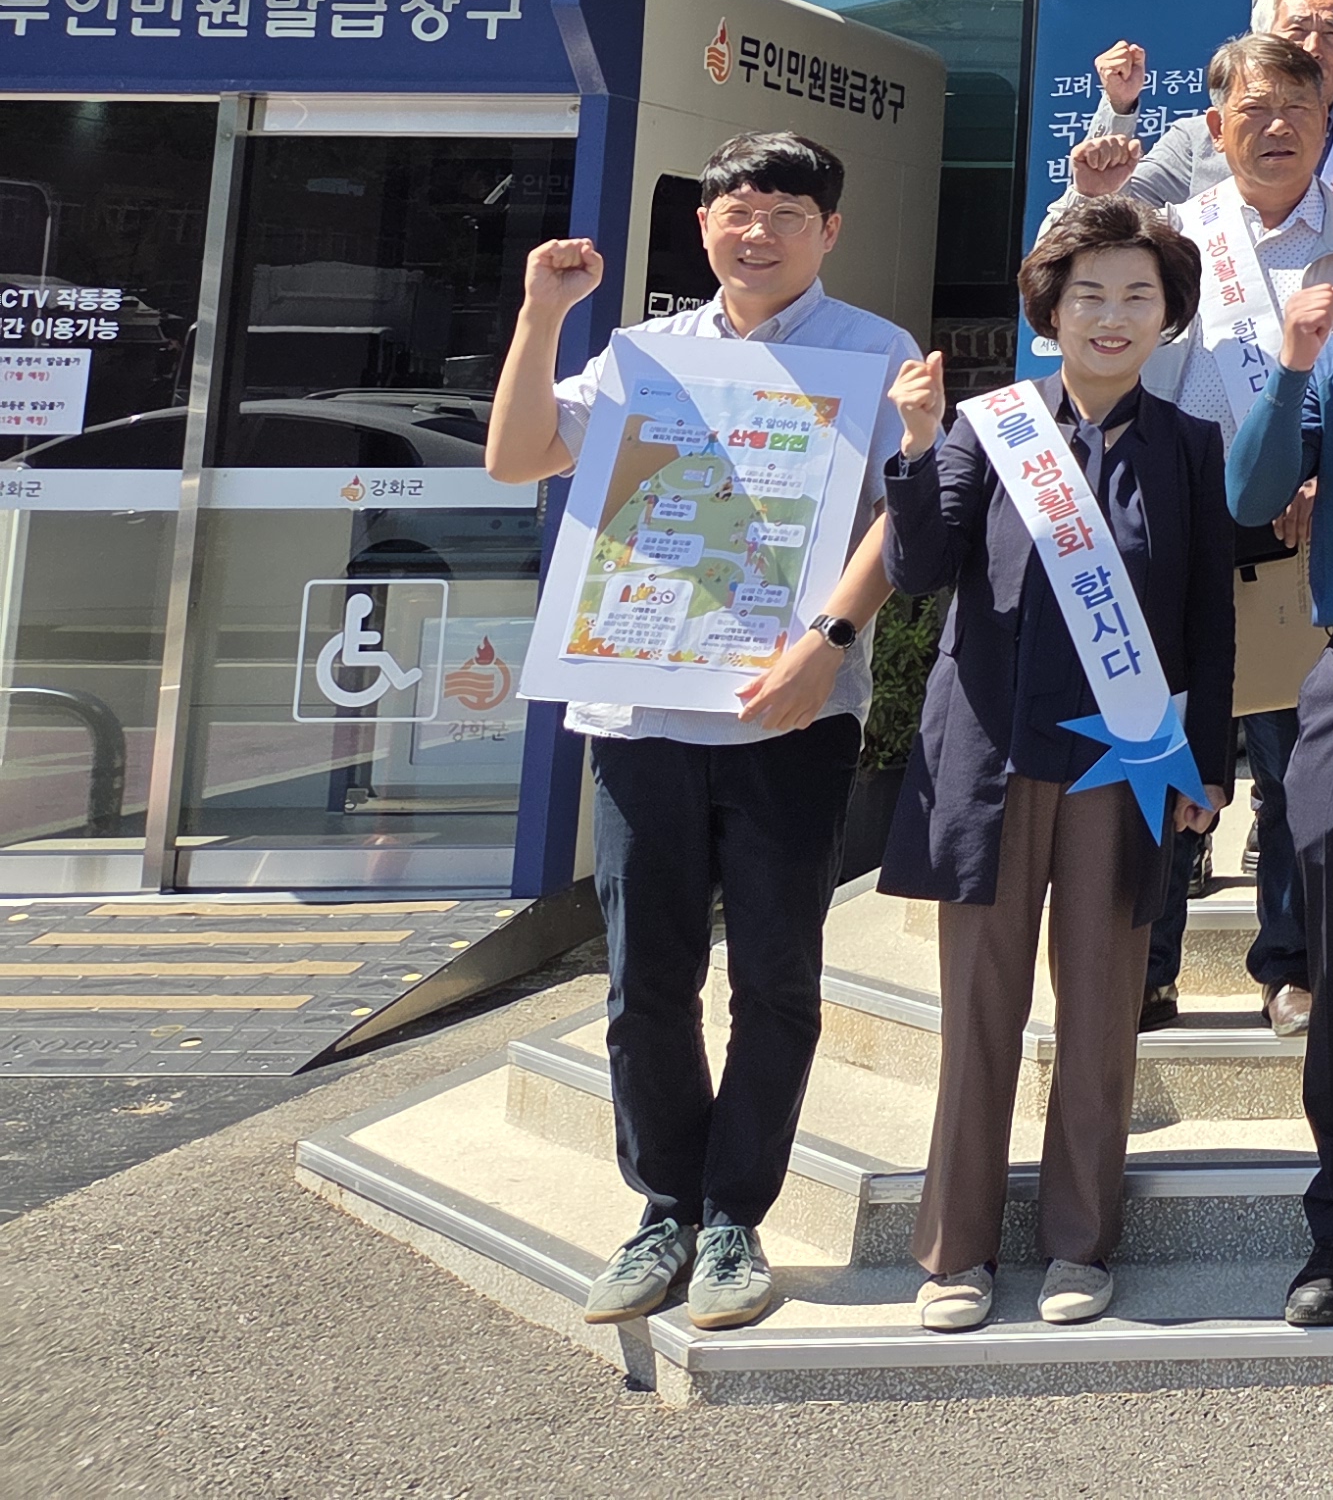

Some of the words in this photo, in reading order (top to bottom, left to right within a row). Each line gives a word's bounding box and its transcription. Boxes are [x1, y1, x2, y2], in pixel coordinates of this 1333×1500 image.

[738, 36, 906, 124] 무인민원발급창구
[1051, 73, 1092, 98] 고려
[1162, 68, 1204, 95] 중심
[1206, 232, 1246, 307] 생활화
[0, 288, 50, 309] CTV
[56, 288, 123, 311] 작동중
[0, 317, 26, 340] 간
[31, 317, 120, 340] 이용가능
[727, 429, 770, 450] 산행
[768, 432, 810, 453] 안전
[370, 479, 424, 497] 강화군
[1019, 449, 1096, 559] 생활화
[1071, 565, 1142, 681] 합시다
[448, 720, 509, 742] 강화군
